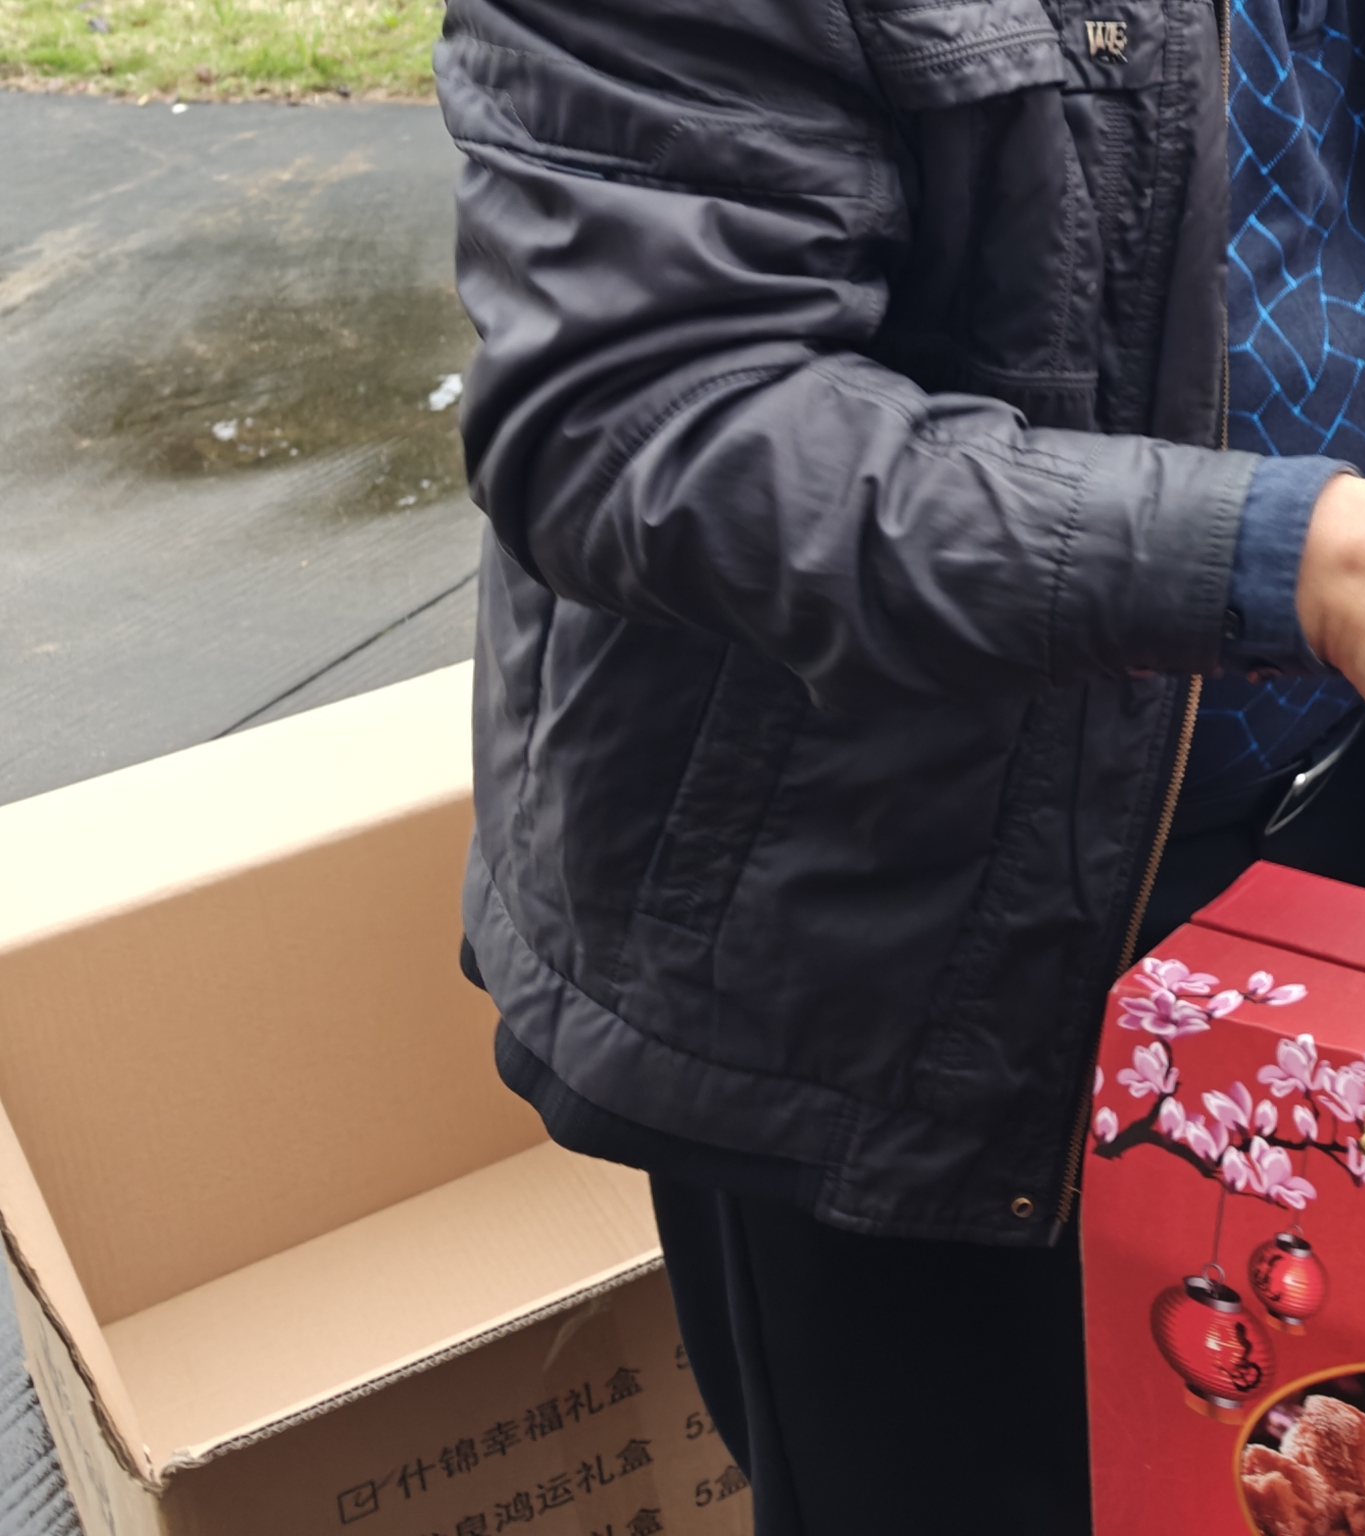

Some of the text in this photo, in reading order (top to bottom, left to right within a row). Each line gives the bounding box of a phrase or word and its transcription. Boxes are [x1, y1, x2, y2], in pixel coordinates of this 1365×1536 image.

[396, 1366, 644, 1501] 什锦幸福礼盒
